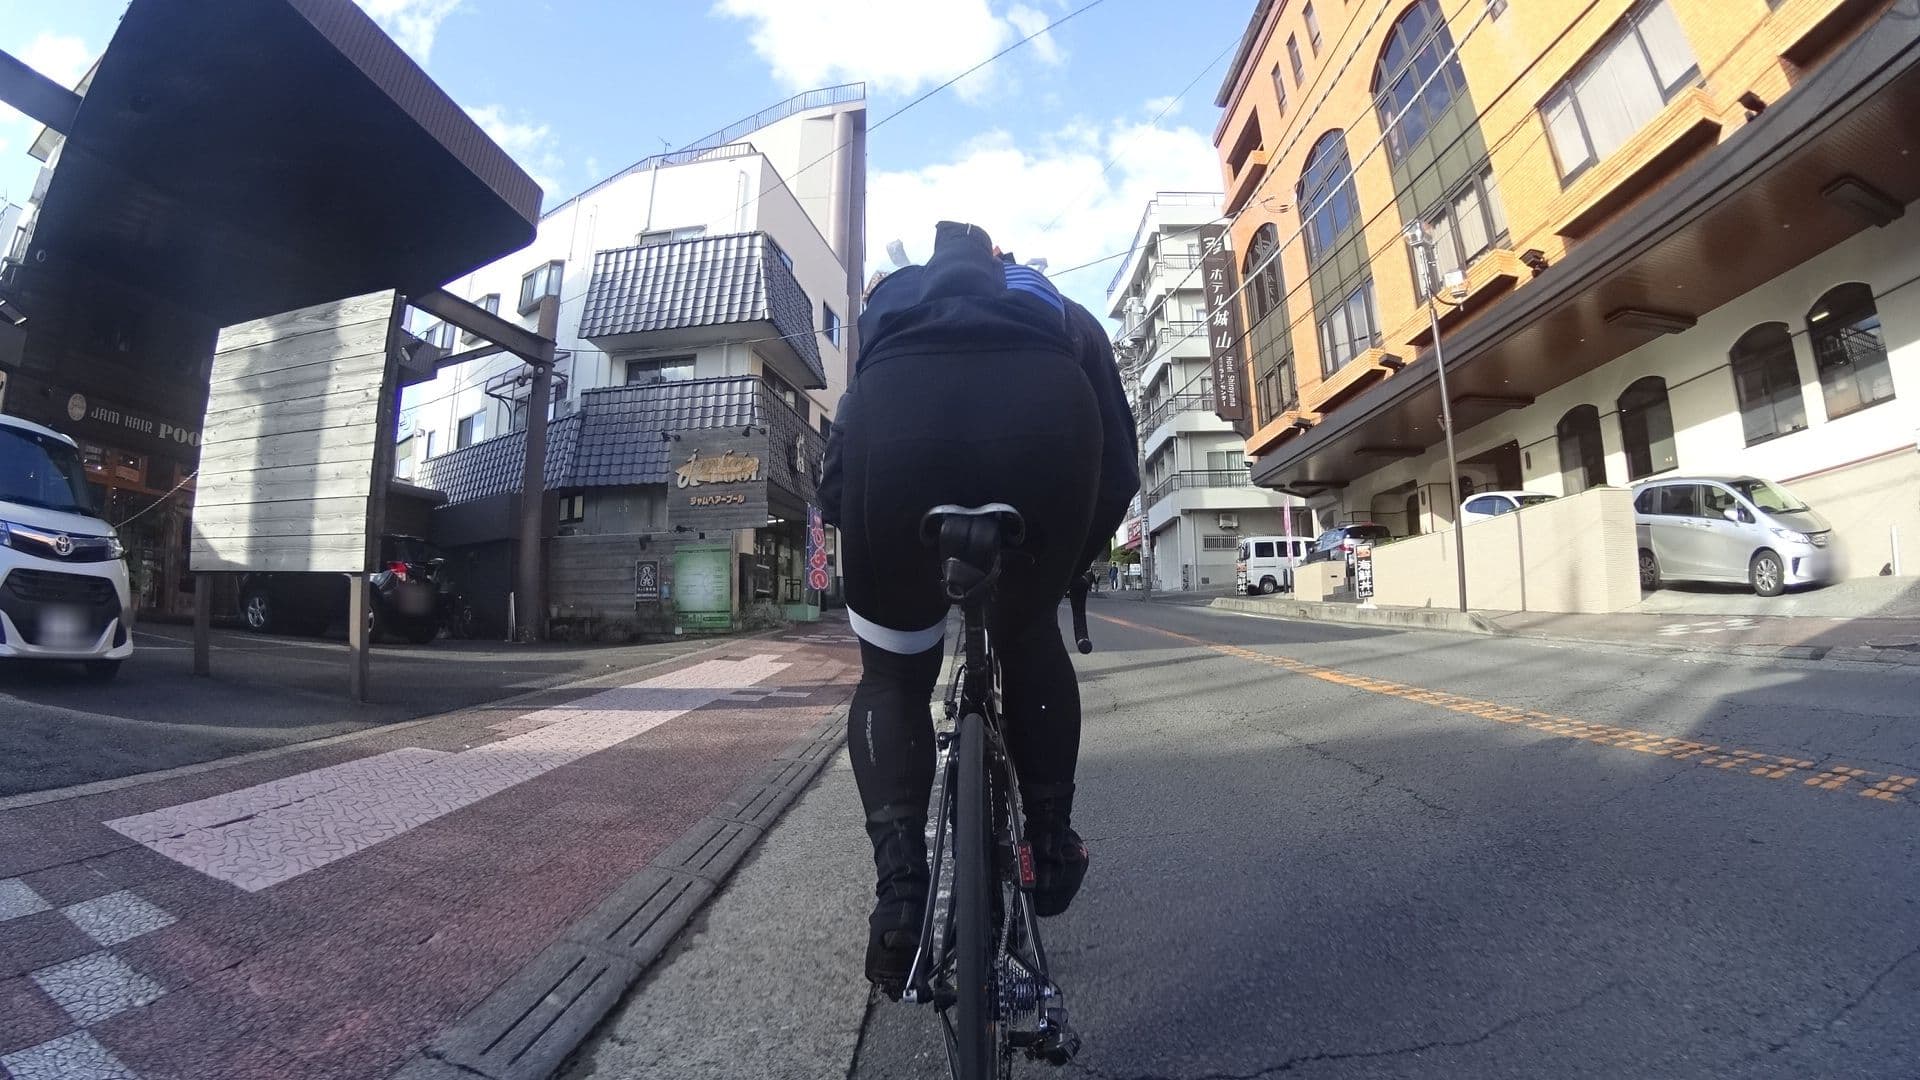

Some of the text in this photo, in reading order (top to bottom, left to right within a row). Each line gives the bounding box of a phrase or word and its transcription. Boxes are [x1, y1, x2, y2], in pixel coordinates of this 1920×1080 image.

[1210, 267, 1232, 349] ホテル城山
[1226, 355, 1234, 373] Hotel
[91, 407, 120, 425] JAM
[124, 415, 154, 434] HAIR
[690, 493, 746, 506] ジャムヘアープール
[1358, 559, 1372, 591] 海鮮丼
